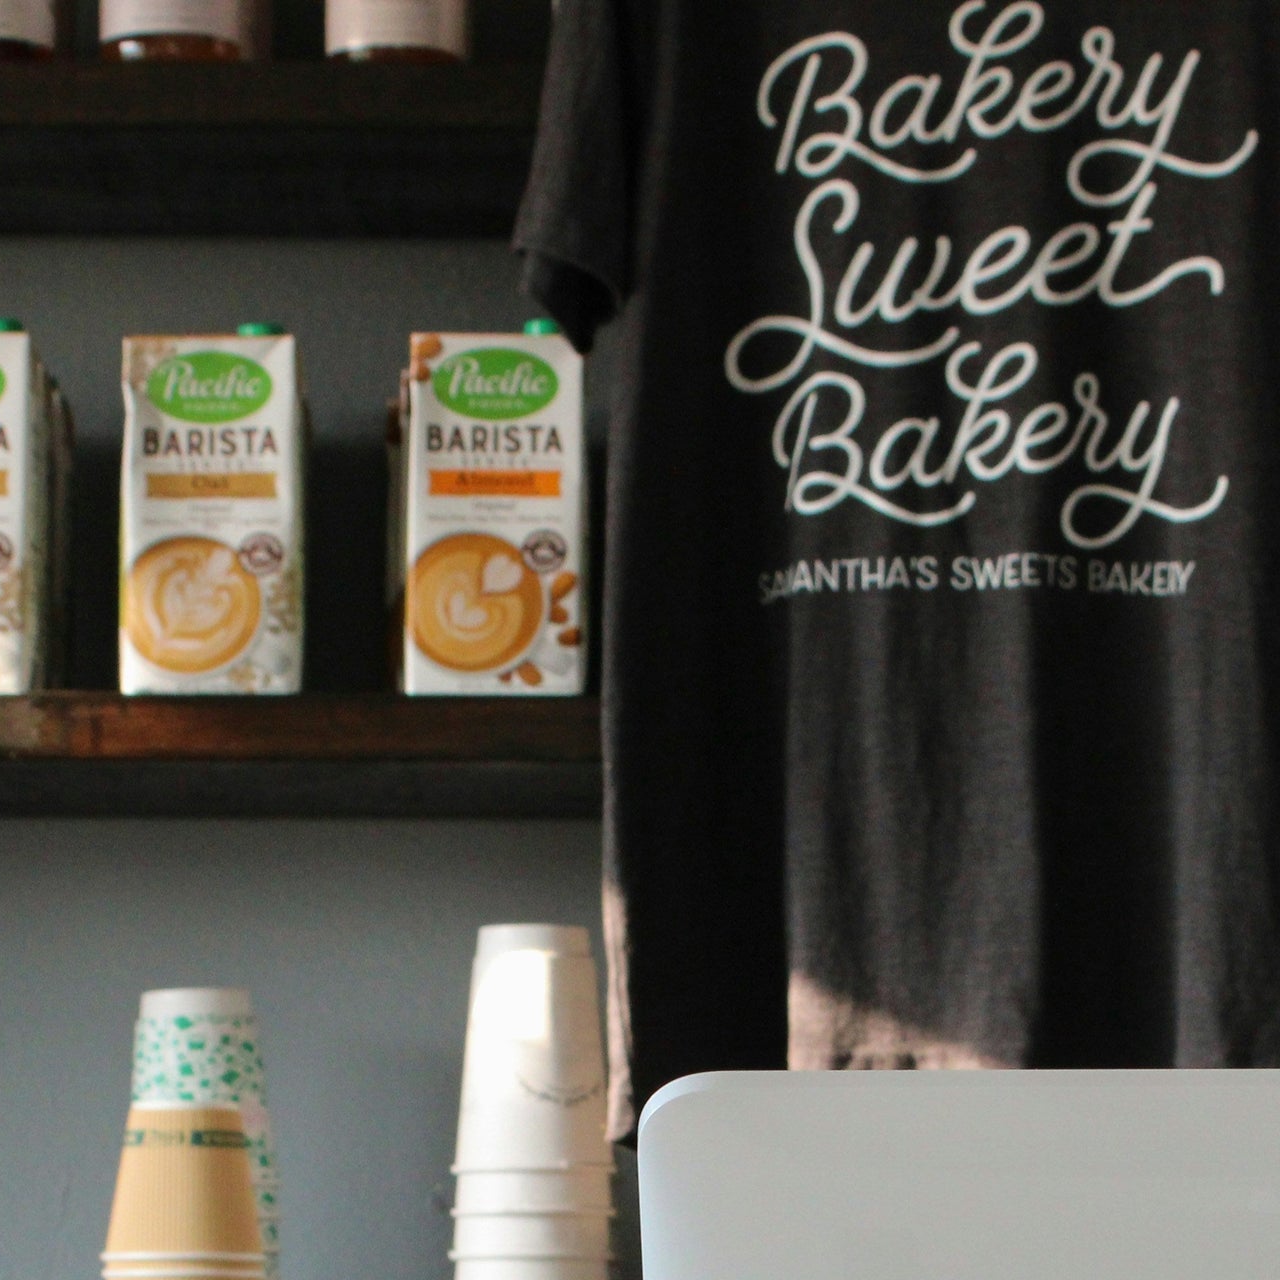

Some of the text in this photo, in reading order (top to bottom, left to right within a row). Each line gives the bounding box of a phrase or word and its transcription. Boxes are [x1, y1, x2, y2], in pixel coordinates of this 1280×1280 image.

[757, 0, 1258, 206] Bakery
[725, 178, 1224, 393] Sweet
[159, 360, 263, 402] Pacific
[444, 356, 549, 399] Pacific
[142, 427, 278, 456] BARISTA
[426, 424, 563, 453] BARISTA
[772, 342, 1228, 548] Bakery
[759, 555, 938, 604] SAANTHA'S
[950, 552, 1077, 592] SWEETS
